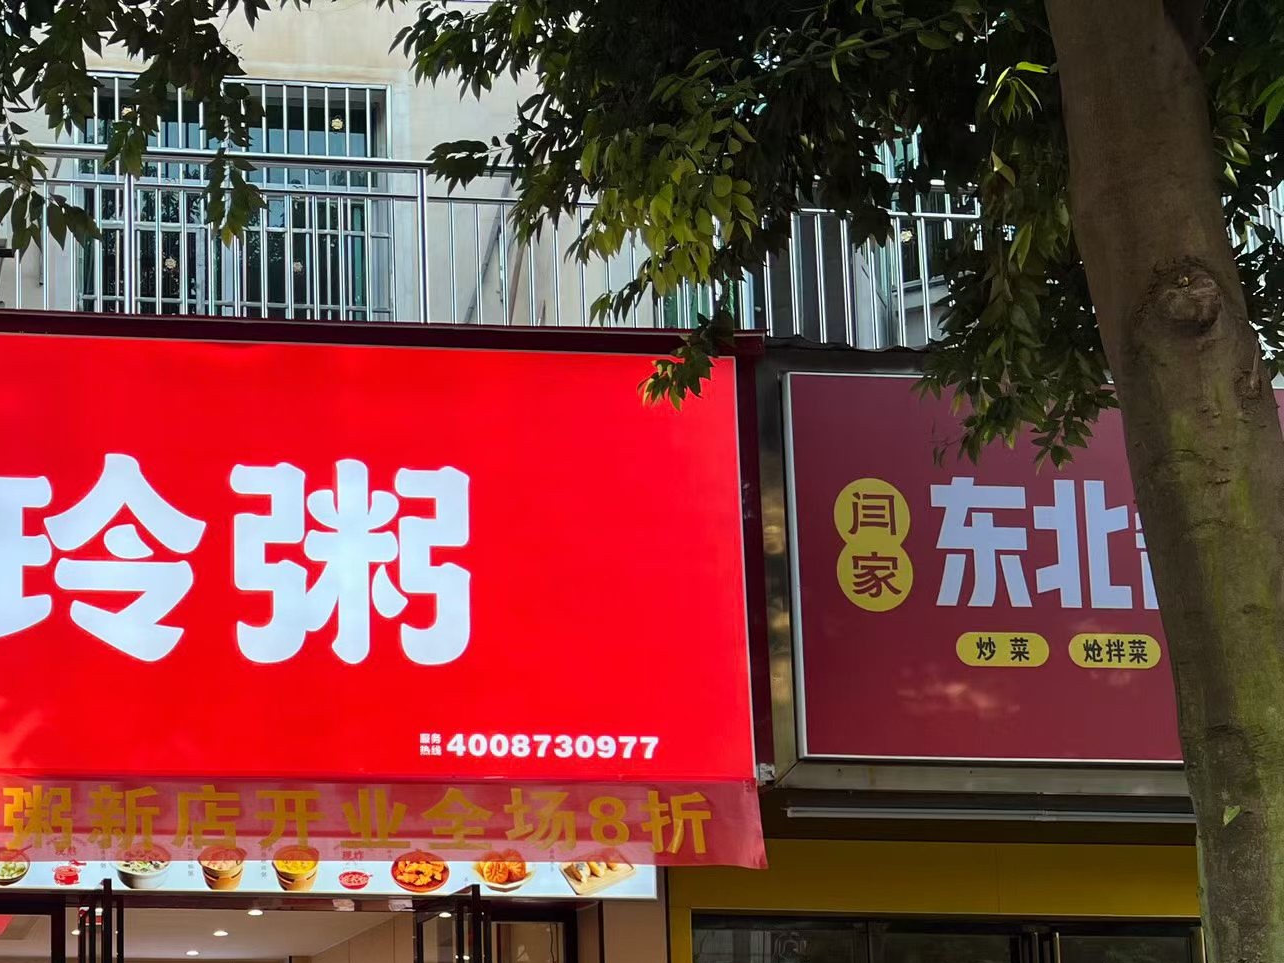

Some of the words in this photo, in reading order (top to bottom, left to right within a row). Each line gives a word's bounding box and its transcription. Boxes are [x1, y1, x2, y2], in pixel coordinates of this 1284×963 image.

[849, 491, 903, 599] 闫家
[929, 476, 1161, 610] 东北
[976, 637, 1030, 662] 炒菜
[446, 732, 660, 760] 4008730977
